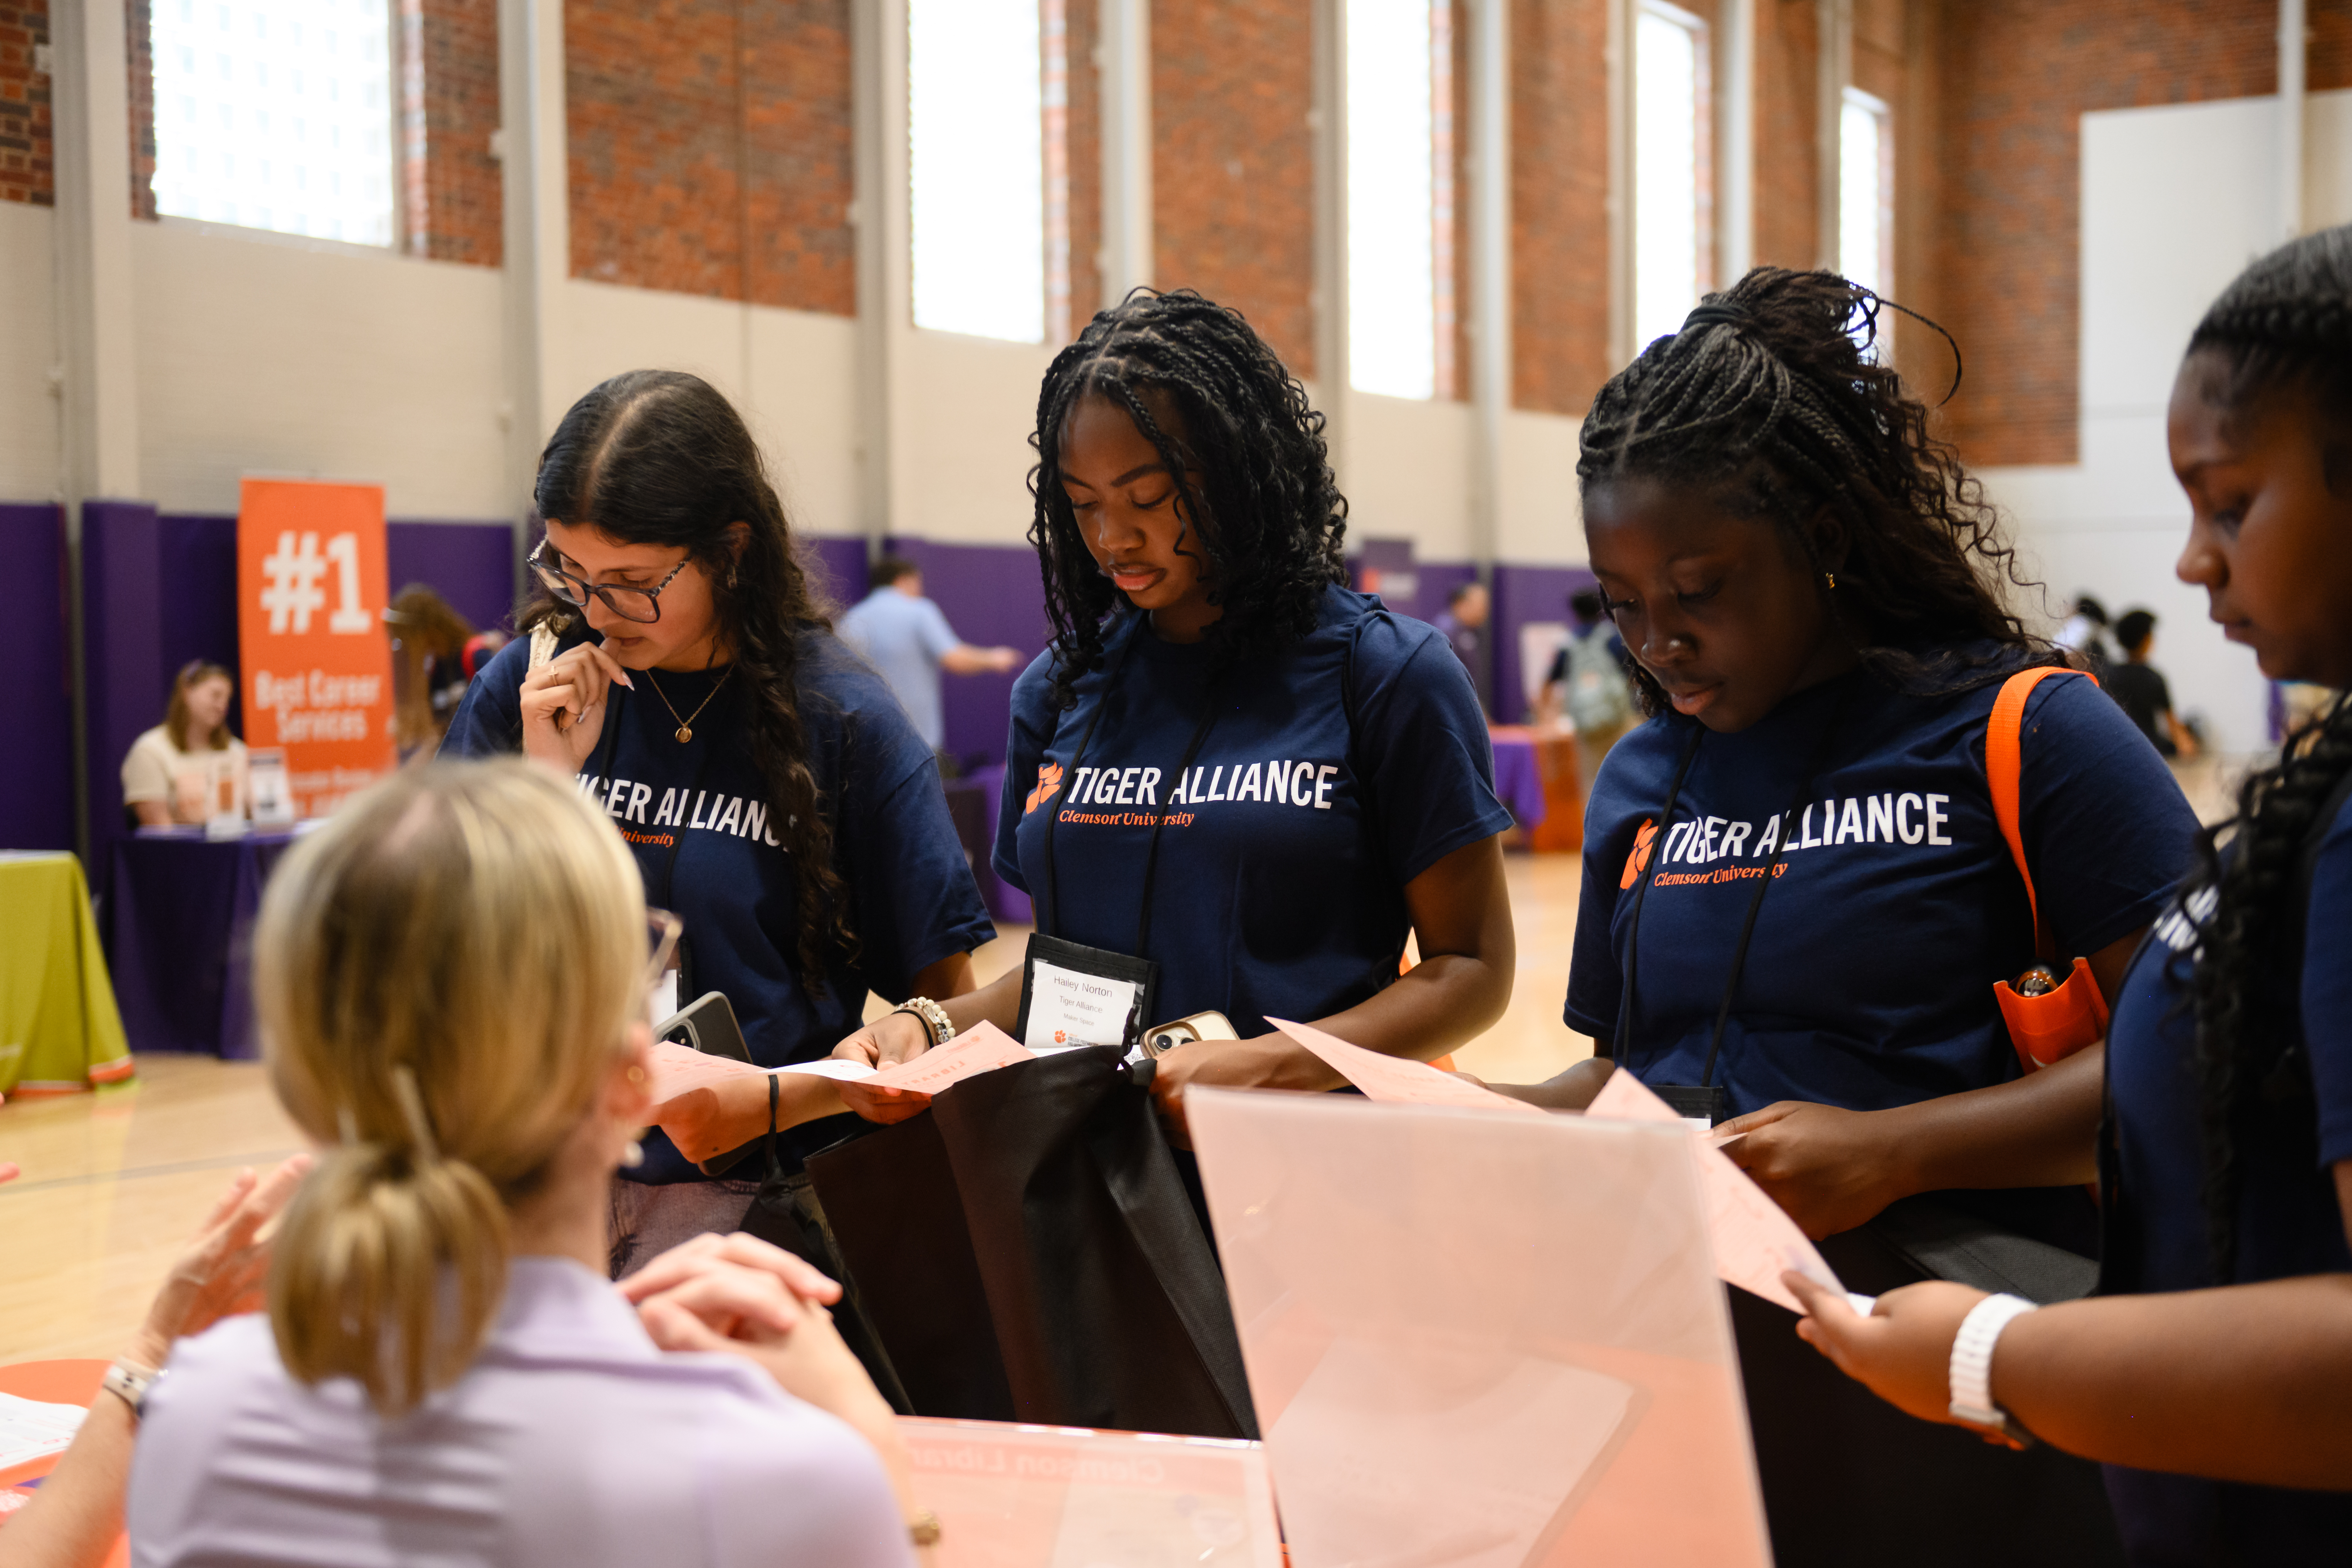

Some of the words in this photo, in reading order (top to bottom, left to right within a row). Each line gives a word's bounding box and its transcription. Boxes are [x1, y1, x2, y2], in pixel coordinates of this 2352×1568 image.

[261, 531, 372, 634] #1
[255, 670, 305, 709] Best
[309, 669, 381, 707] Career
[276, 706, 367, 742] Services
[1067, 767, 1161, 805] TIGER
[1168, 760, 1338, 809] ALLIANCE
[575, 773, 652, 825] IGER
[653, 788, 790, 854] ALLIAN
[1059, 810, 1119, 825] Clemson
[1662, 816, 1752, 865] TIGER
[1654, 872, 1711, 887] Clemson
[1713, 863, 1788, 885] Universty
[1054, 975, 1079, 991] Hailey
[1082, 983, 1112, 998] Norton
[1059, 995, 1075, 1008] Tiger
[1076, 1001, 1103, 1014] Alliance
[1064, 1013, 1078, 1021] Maker
[1079, 1017, 1095, 1027] Space
